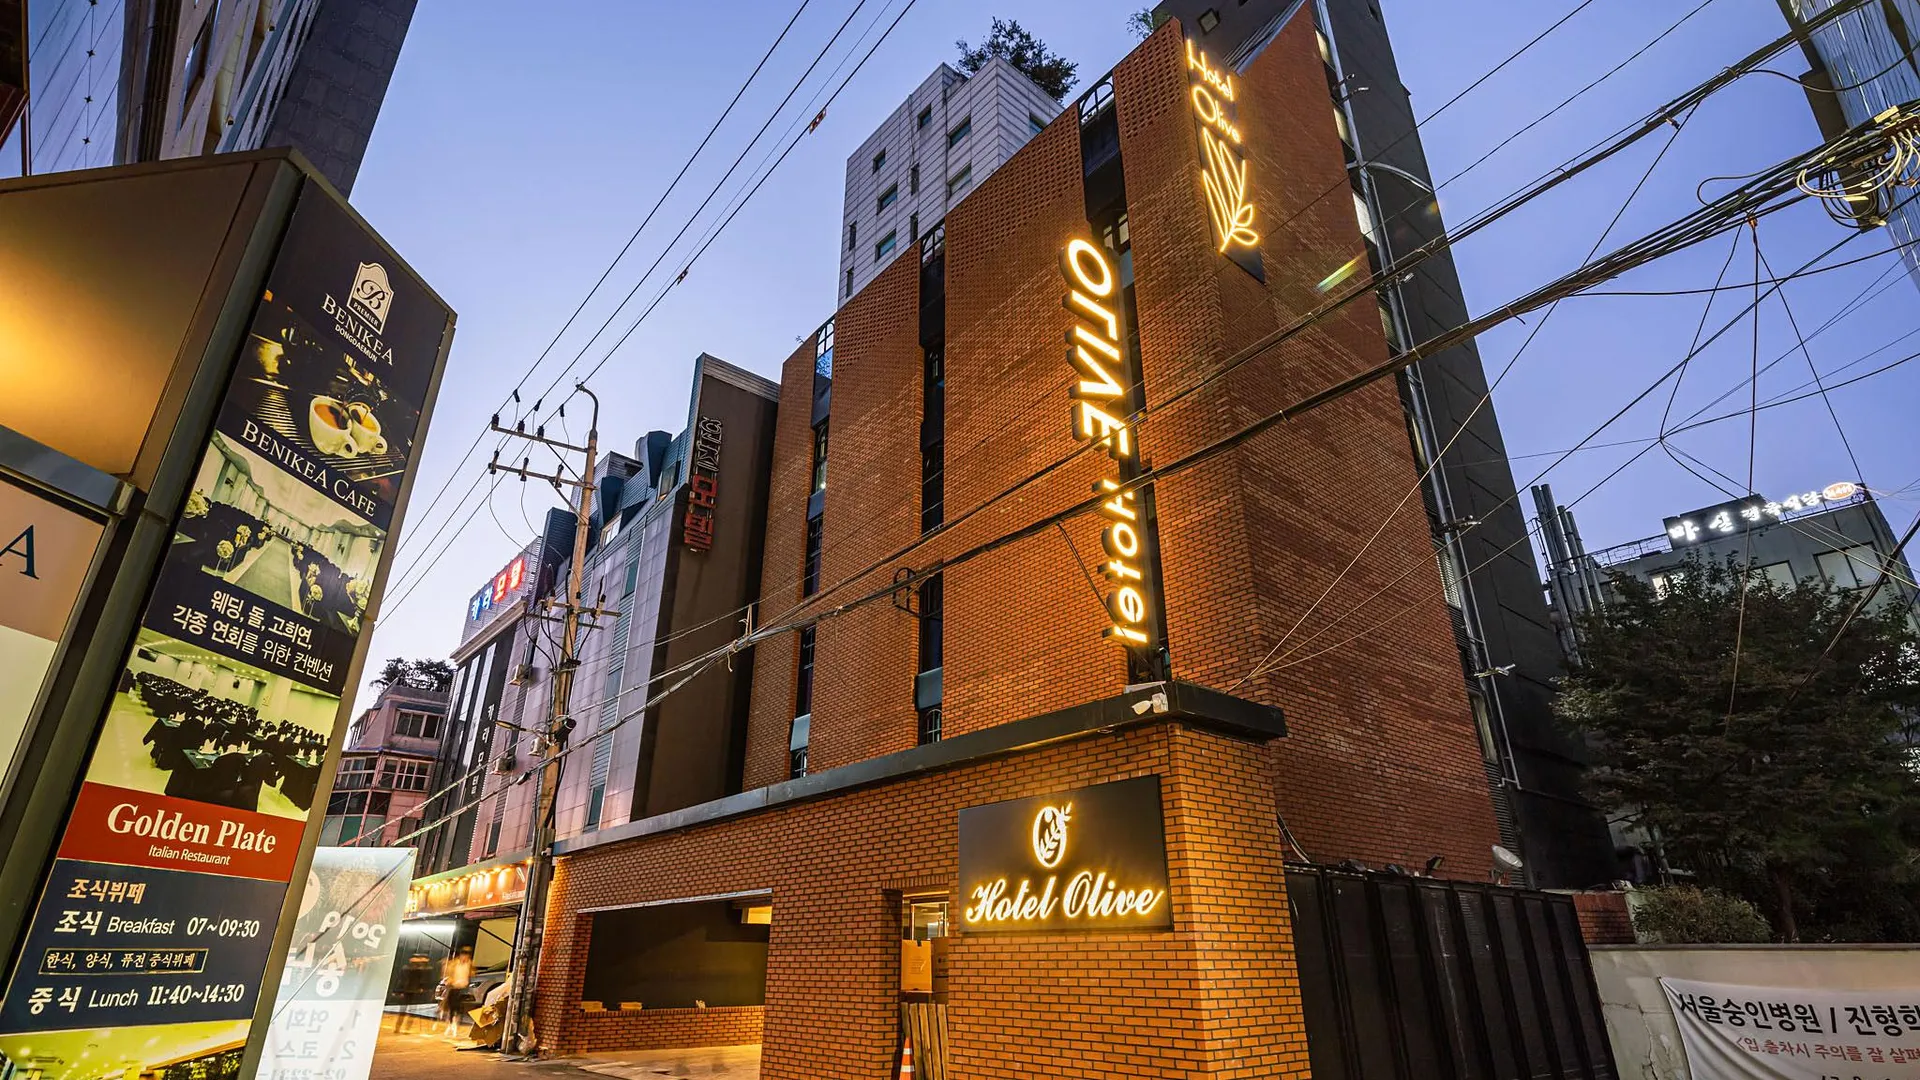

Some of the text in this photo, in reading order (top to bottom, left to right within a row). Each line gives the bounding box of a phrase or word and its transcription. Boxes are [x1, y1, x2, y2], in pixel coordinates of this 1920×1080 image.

[1185, 38, 1235, 102] Hotel
[1192, 85, 1242, 144] Olive
[321, 293, 393, 366] BENIKEA
[352, 302, 379, 327] PREMIER
[334, 324, 378, 363] DONGDAEMUN
[1067, 238, 1148, 644] OLIVE Hotel
[240, 419, 377, 517] BENIKEA CAFE
[210, 590, 313, 650] 웨딩, 돌, 고희연,
[173, 604, 334, 684] 각종 연회를 위한 컨벤션
[107, 803, 277, 854] Golden Plate
[149, 844, 231, 866] Italian Restaurant
[67, 878, 147, 905] 조식뷔페
[965, 870, 1165, 923] Hotel Olive
[54, 909, 260, 938] 조식 Breakfast 07~09:30
[46, 952, 76, 970] 한식,
[85, 952, 114, 969] 양식,
[120, 952, 147, 969] 퓨전
[88, 988, 139, 1008] Lunch
[146, 984, 245, 1006] 11:40~14:30
[1678, 993, 1824, 1035] 서울숭인병원
[1814, 1044, 1863, 1062] 주의를
[1866, 1047, 1885, 1063] 잘
